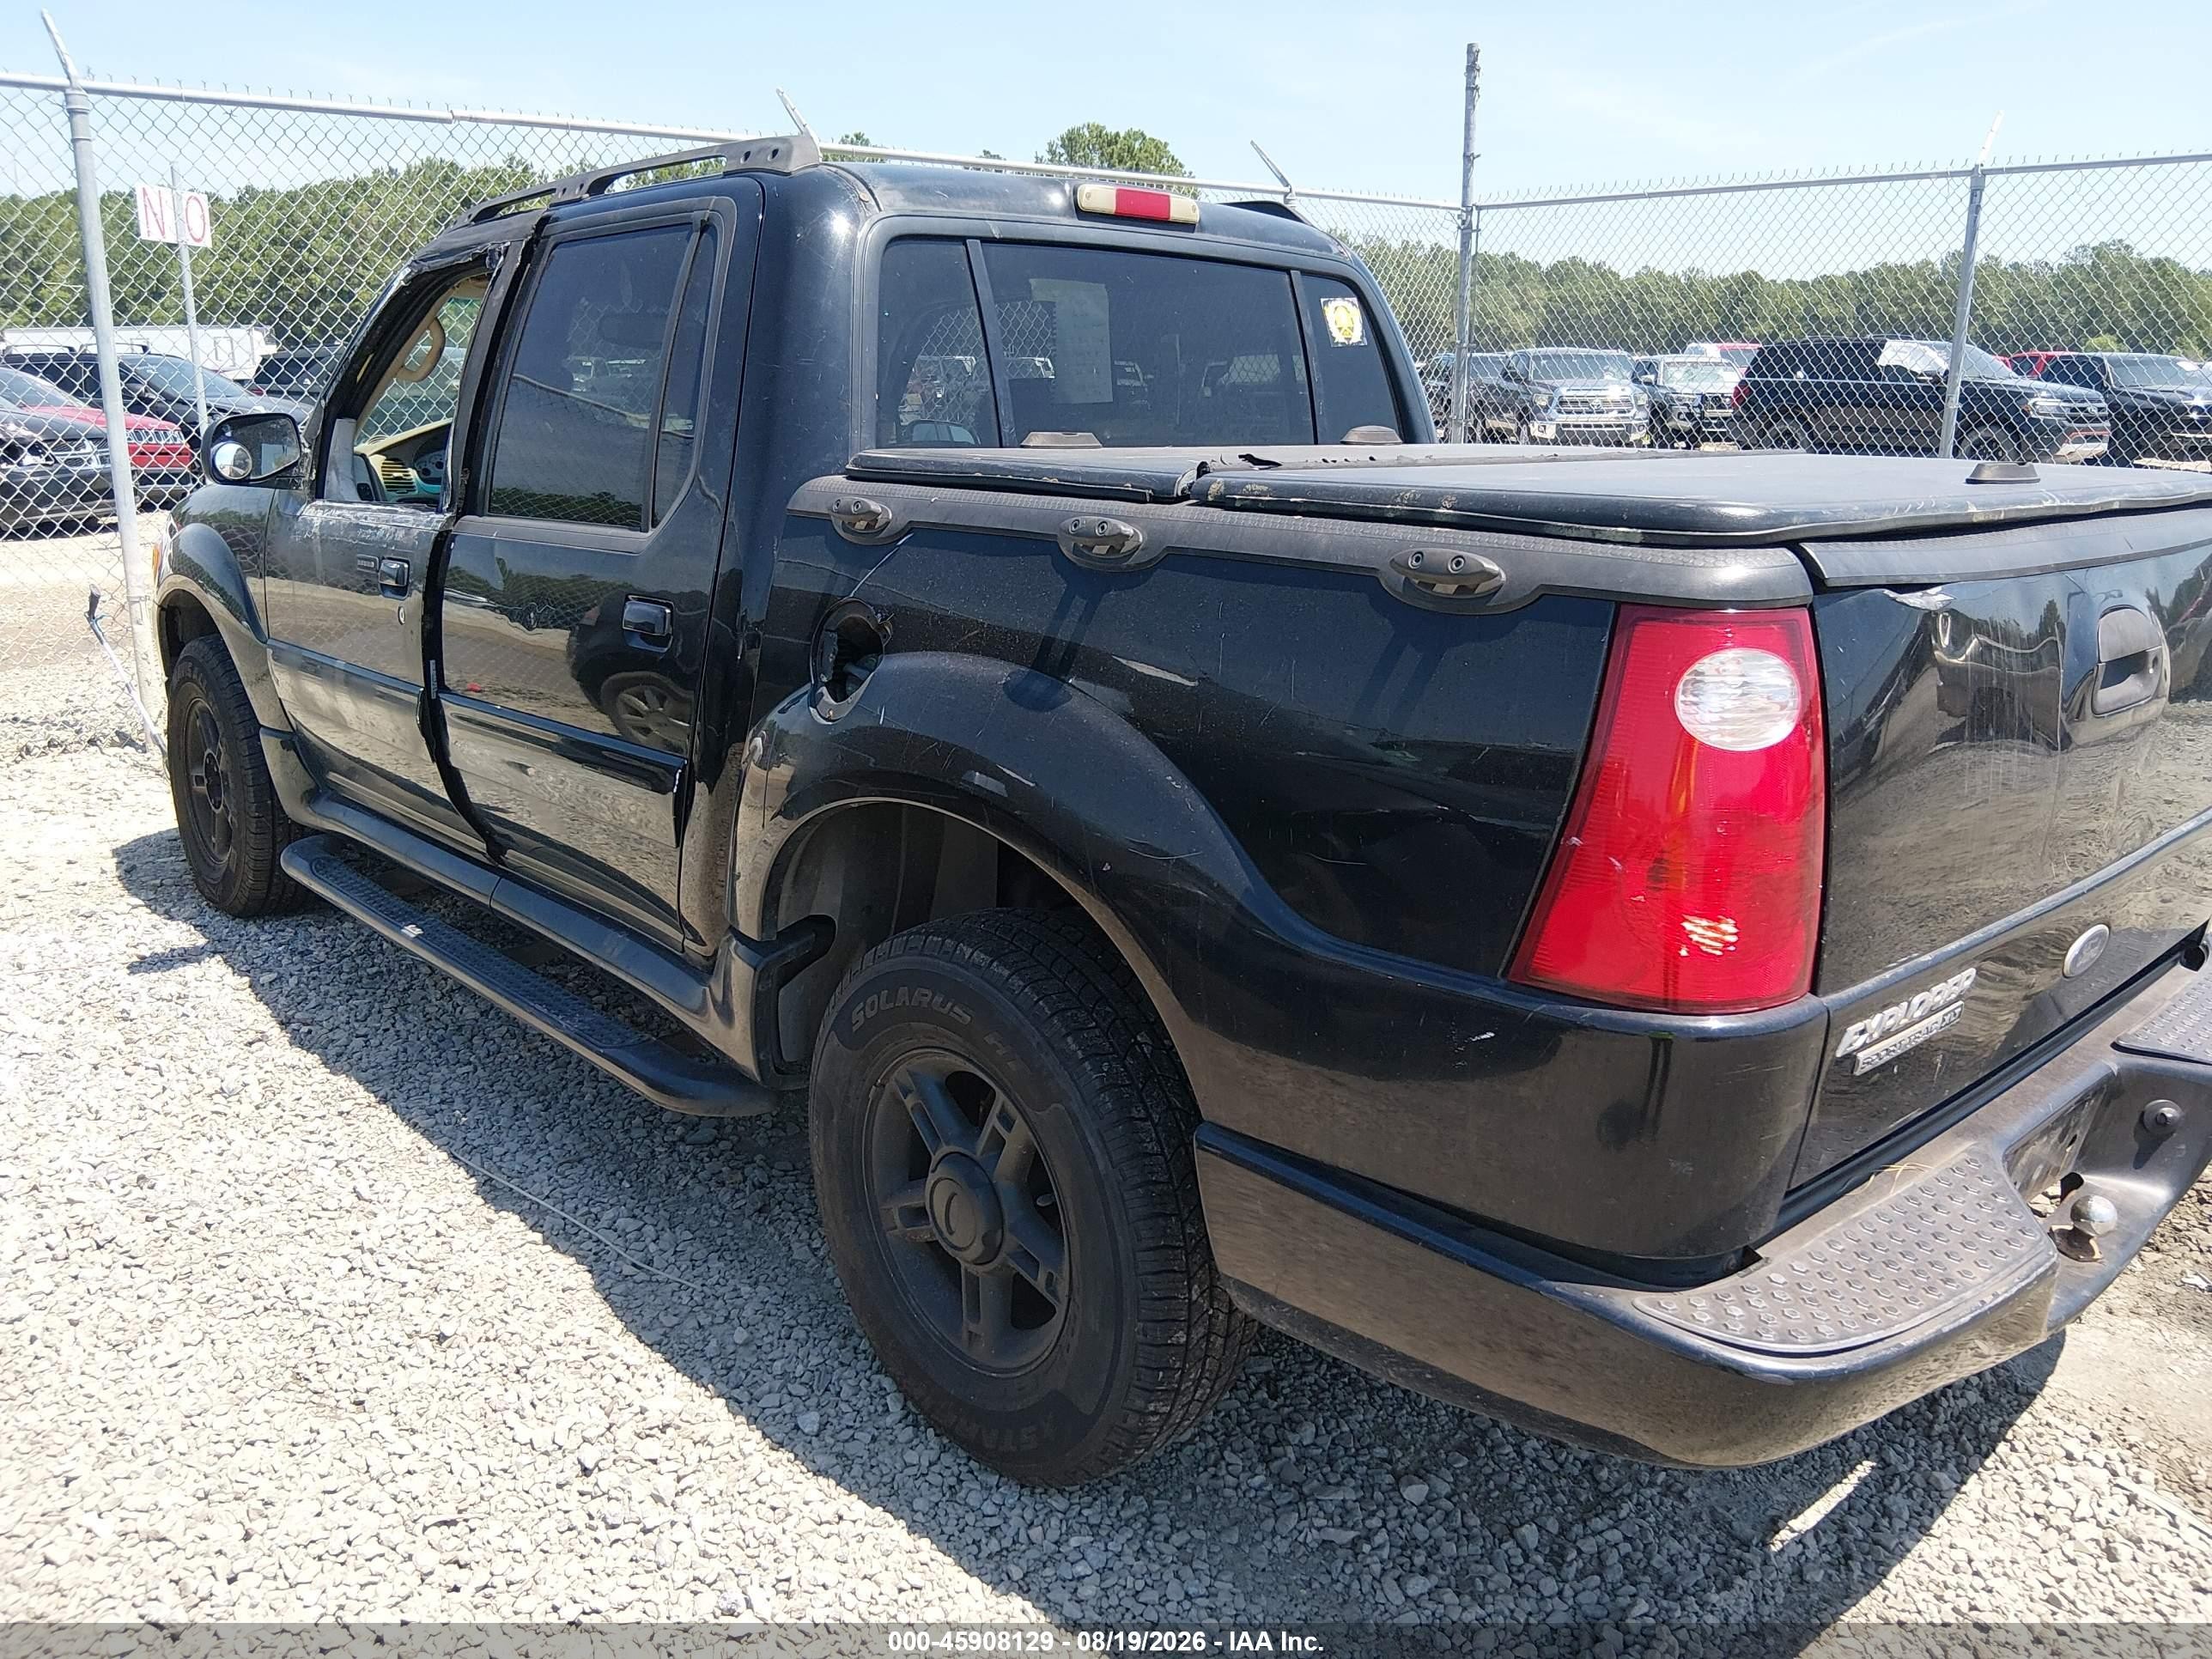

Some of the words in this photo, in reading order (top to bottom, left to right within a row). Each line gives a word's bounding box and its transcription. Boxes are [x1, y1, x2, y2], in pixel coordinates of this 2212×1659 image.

[142, 186, 206, 243] NO
[851, 987, 972, 1031] SOLARUS
[1836, 968, 1977, 1057] EXPLORER
